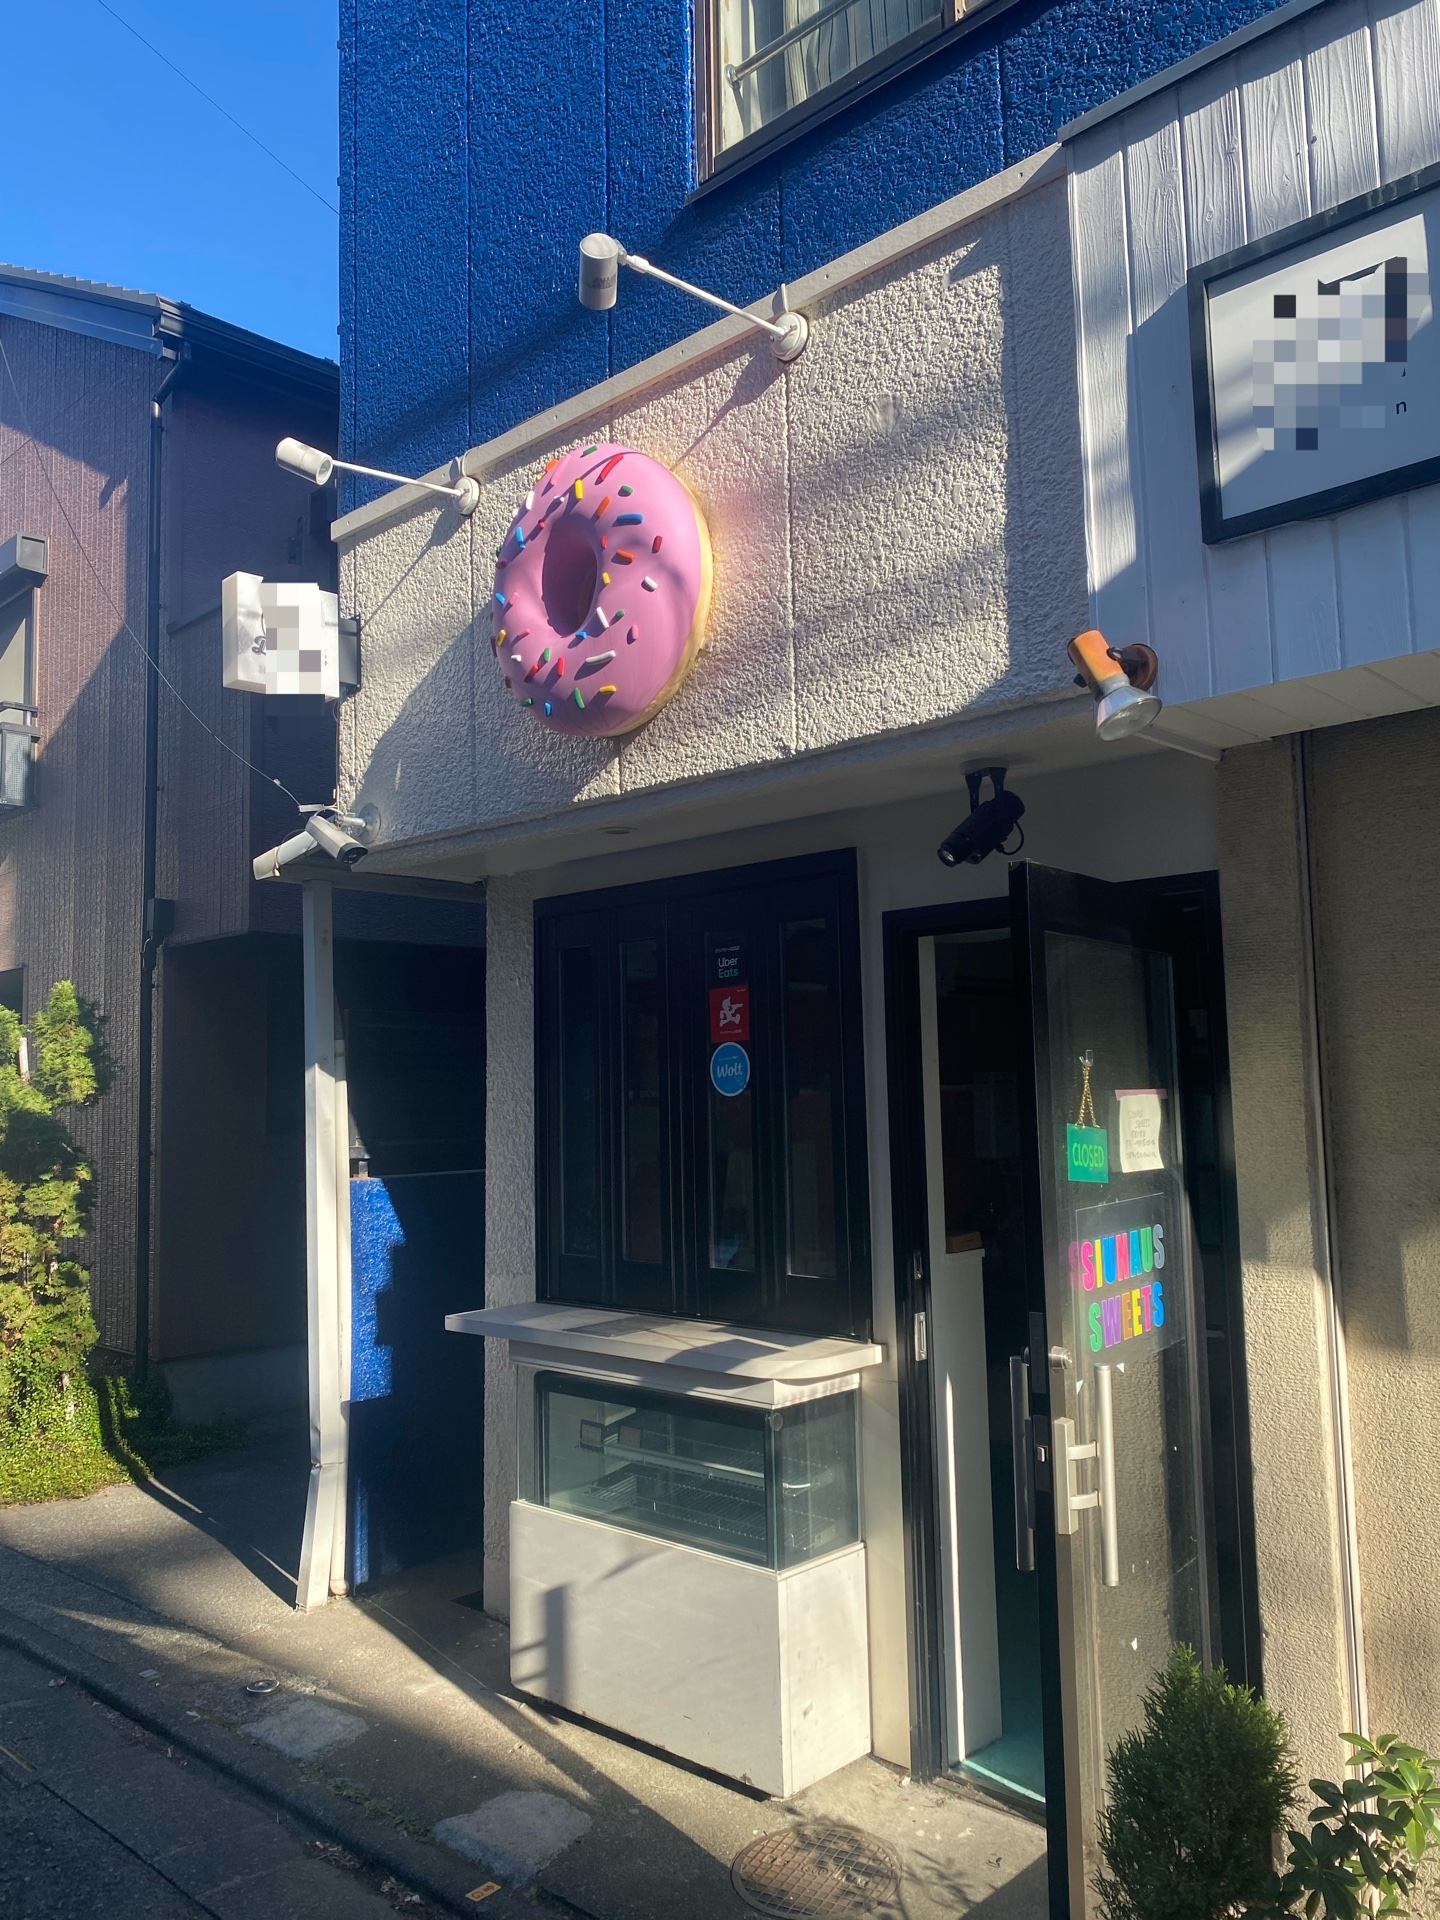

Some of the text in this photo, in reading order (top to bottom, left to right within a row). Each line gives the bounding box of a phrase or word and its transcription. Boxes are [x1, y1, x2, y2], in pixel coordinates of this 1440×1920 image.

[718, 956, 738, 967] Uber
[718, 967, 739, 979] Eats
[717, 1062, 743, 1078] Wolt
[1073, 1142, 1105, 1168] CLOSED
[1081, 1224, 1165, 1291] SIUNAUS
[1089, 1281, 1165, 1352] SWEETS
